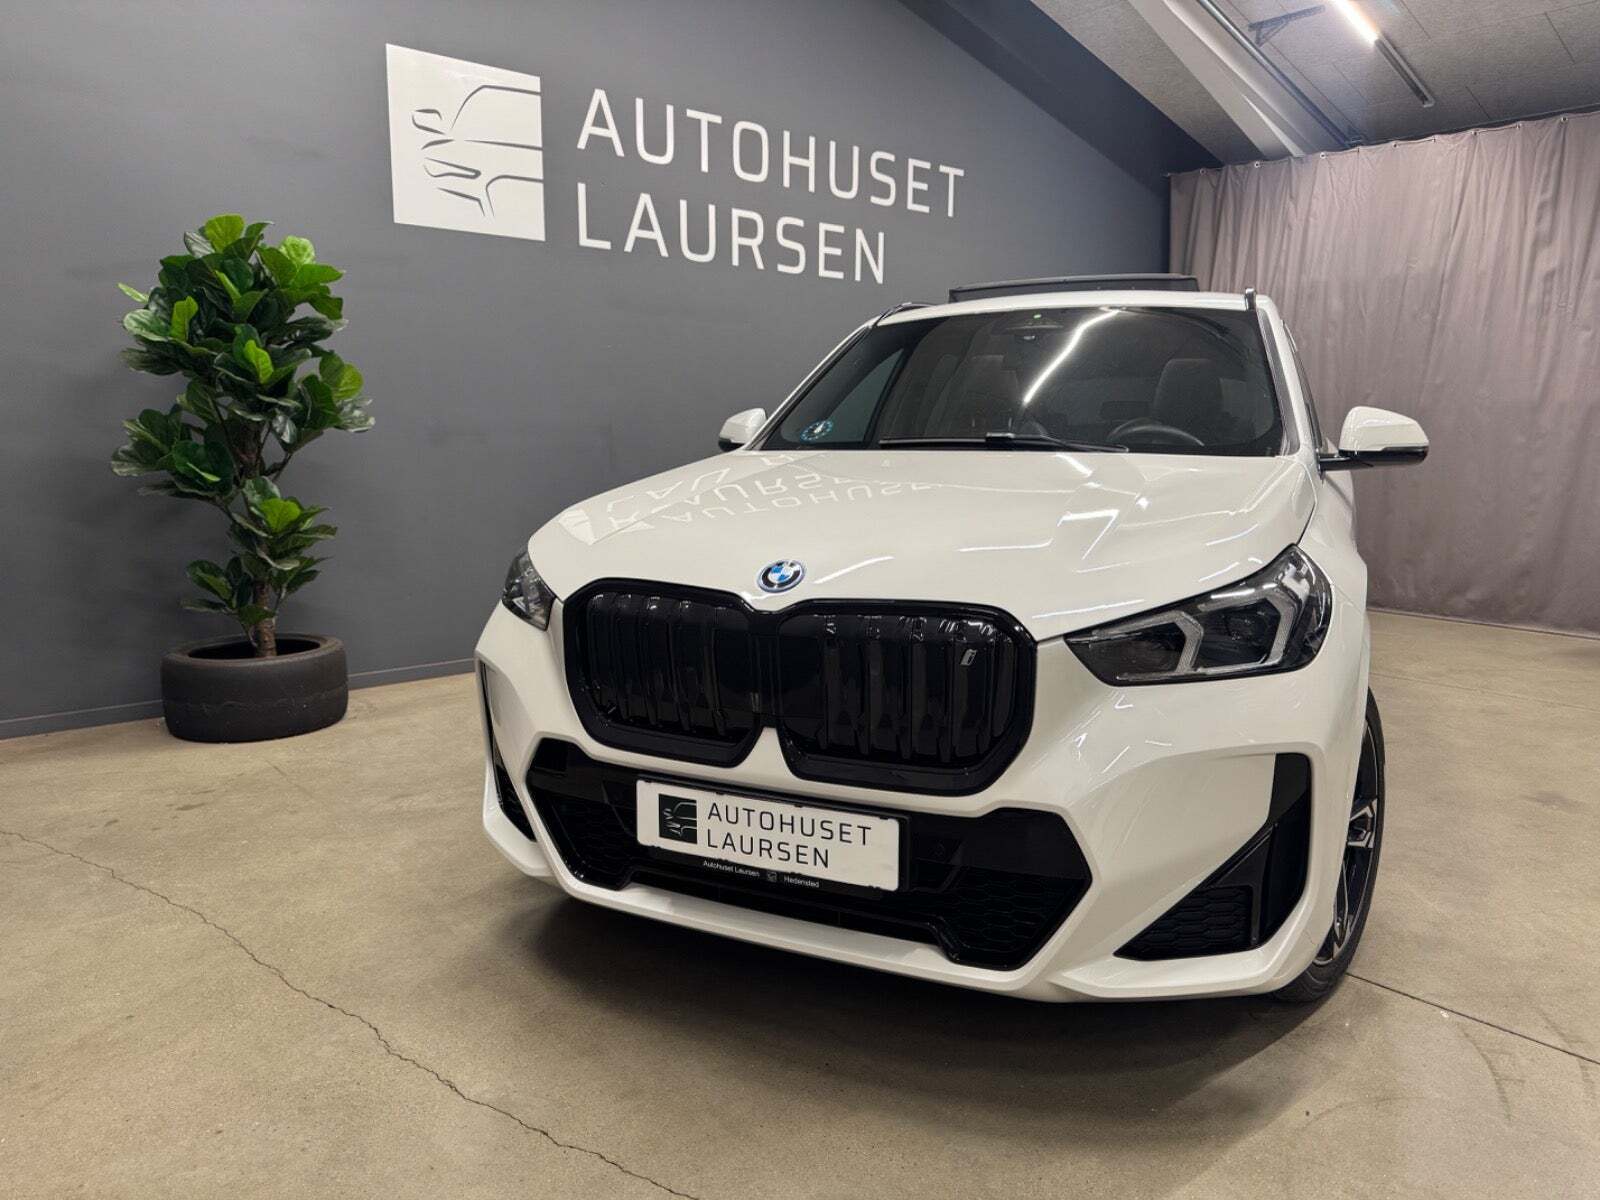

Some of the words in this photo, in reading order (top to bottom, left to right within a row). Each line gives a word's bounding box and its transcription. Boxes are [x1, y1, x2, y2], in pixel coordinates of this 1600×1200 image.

[577, 88, 964, 217] AUTOHUSET
[577, 182, 885, 284] LAURSEN
[707, 829, 829, 868] LAURSEN
[708, 803, 871, 845] AUTOHUSET
